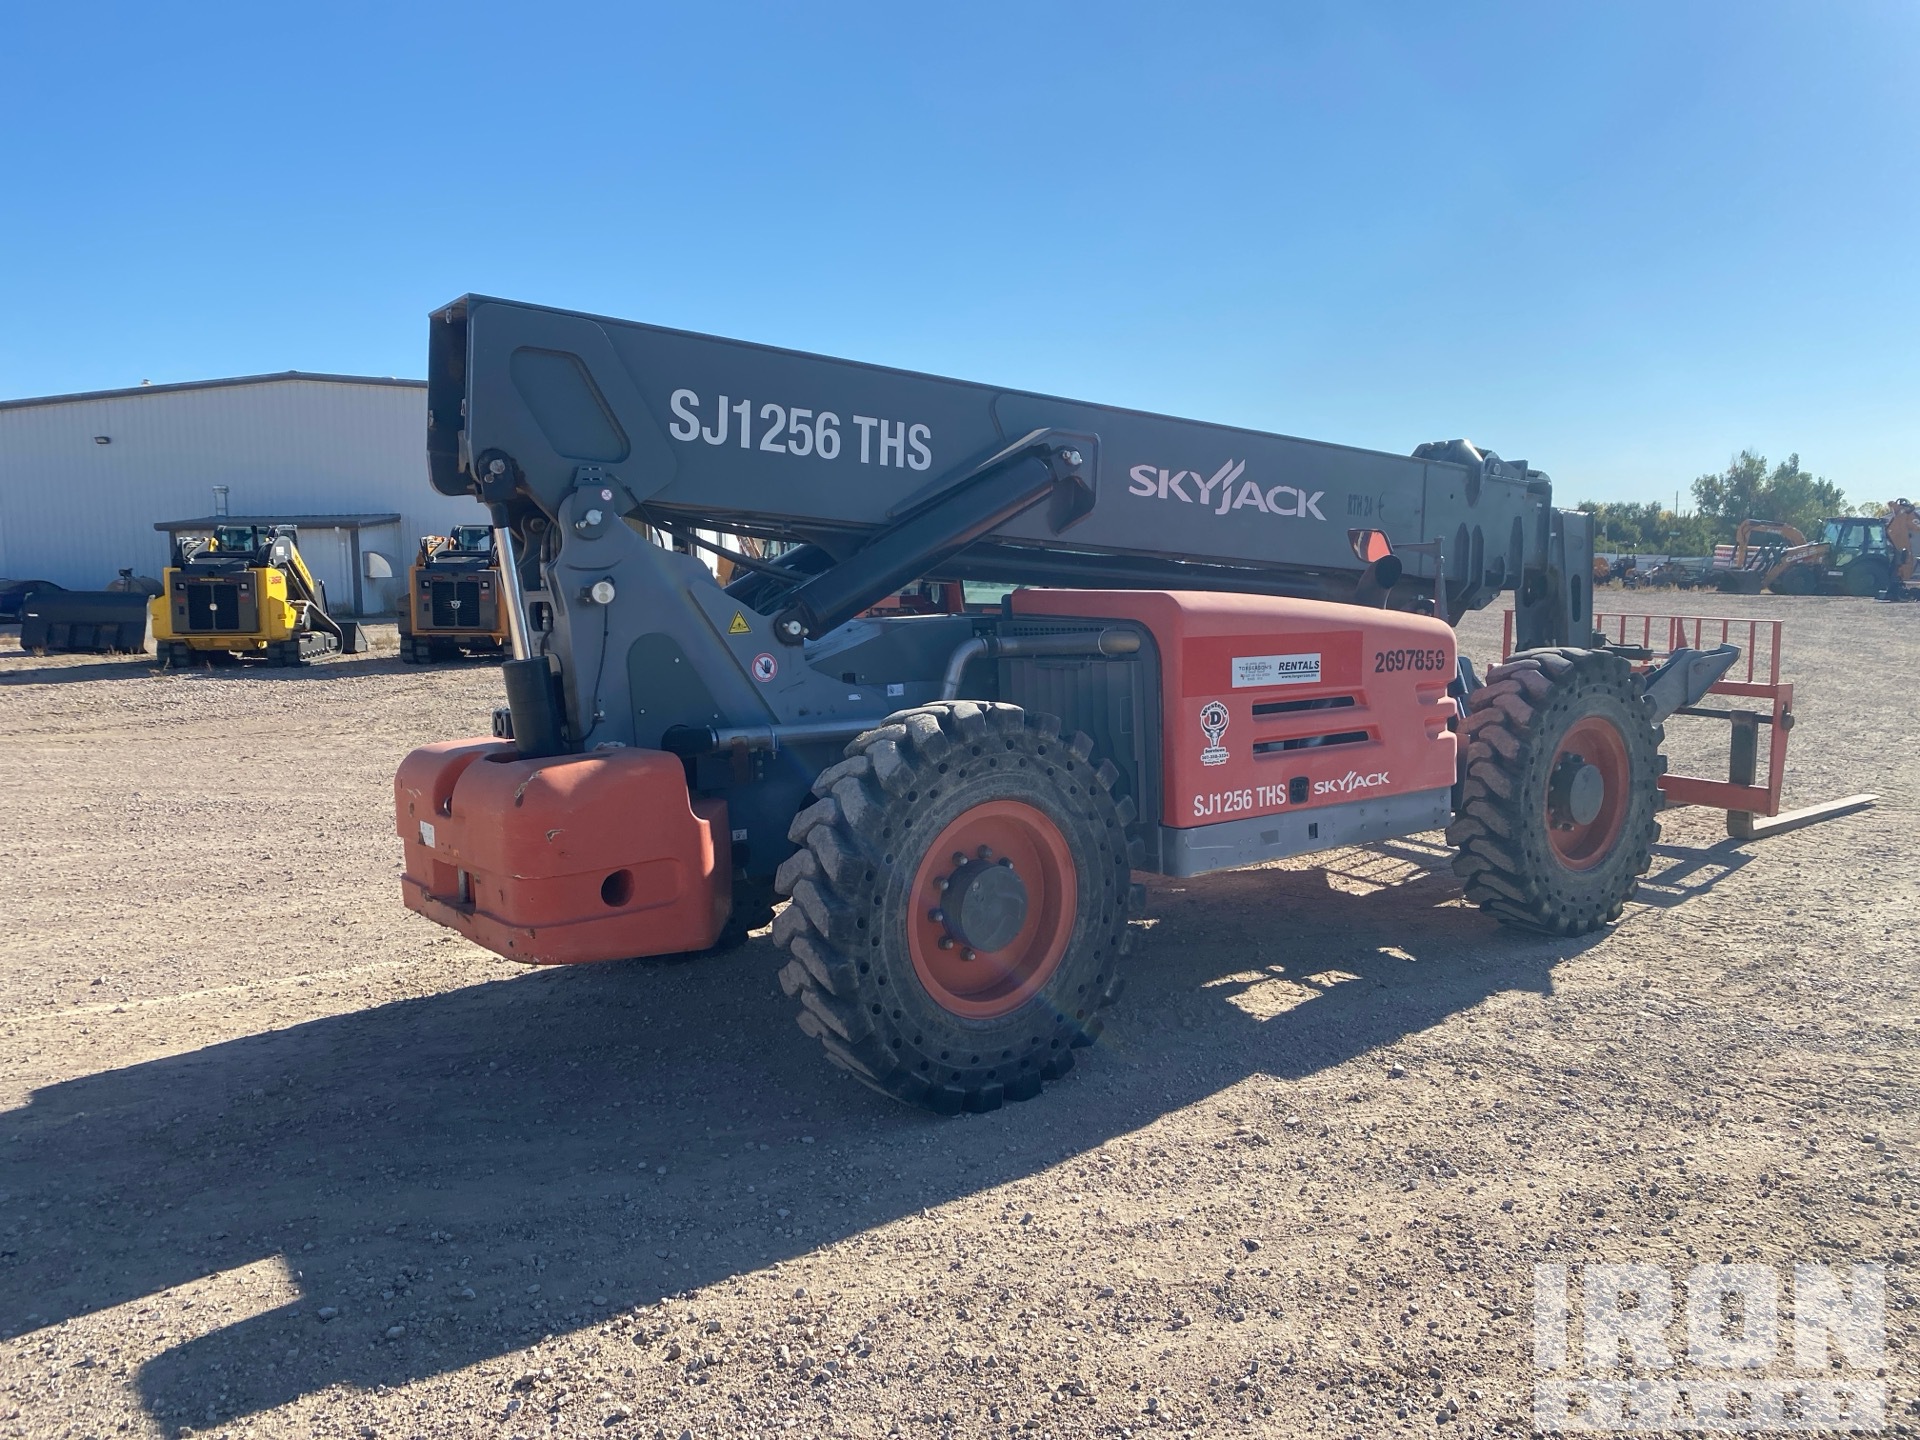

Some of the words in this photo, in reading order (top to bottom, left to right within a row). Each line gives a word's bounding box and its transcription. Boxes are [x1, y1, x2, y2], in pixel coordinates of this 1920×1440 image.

[669, 388, 841, 460] SJ1256
[852, 414, 933, 471] THS
[1128, 458, 1328, 522] SKYJACK
[1786, 551, 1808, 563] CASE
[1278, 660, 1320, 671] RENTALS
[1375, 649, 1445, 673] 2697859
[1201, 702, 1228, 716] Western
[1210, 711, 1222, 726] D
[1313, 770, 1391, 794] SKYJACK
[1193, 789, 1252, 817] SJ1256
[1256, 783, 1287, 808] THS
